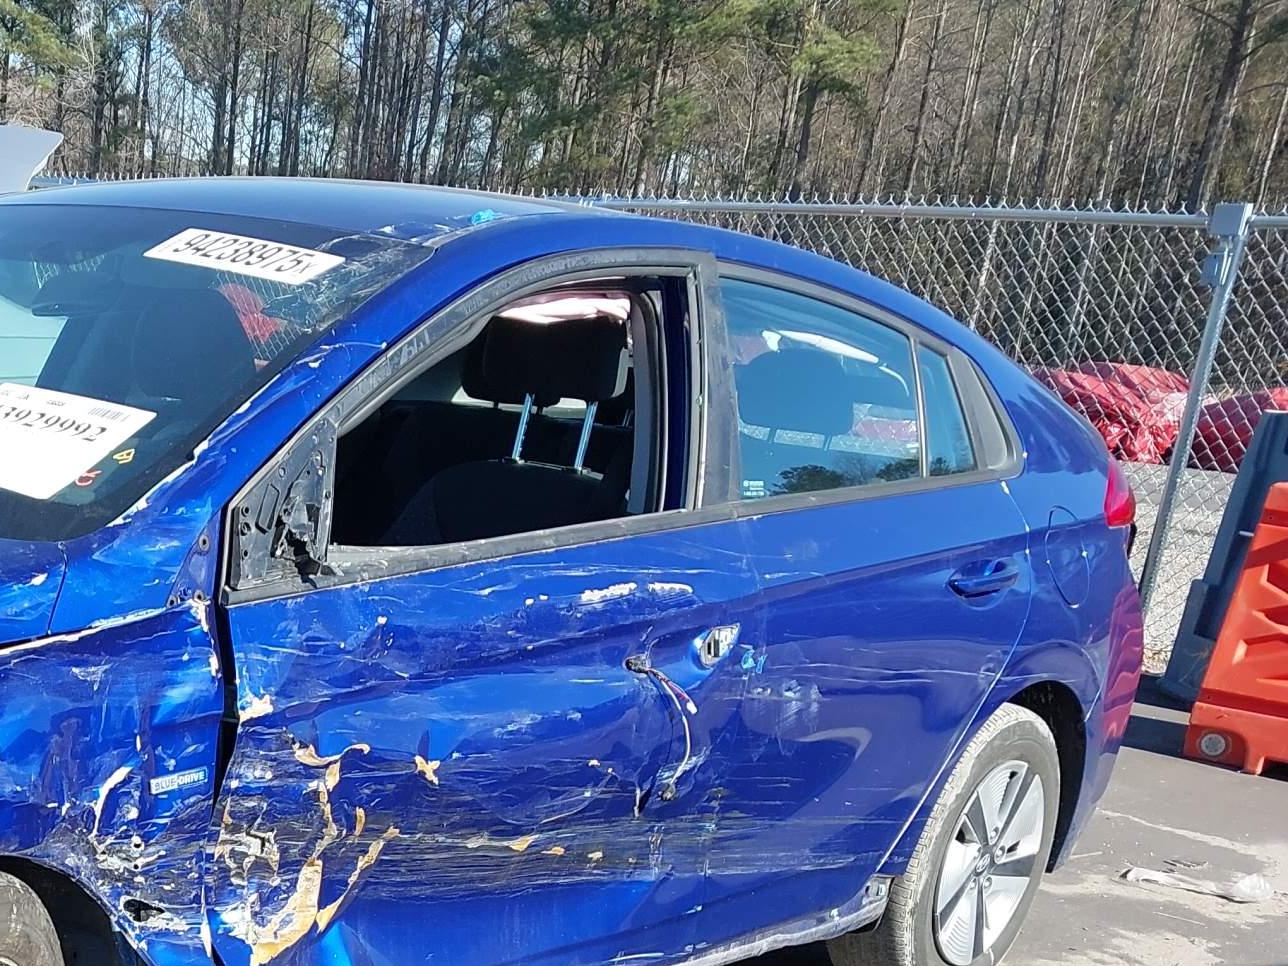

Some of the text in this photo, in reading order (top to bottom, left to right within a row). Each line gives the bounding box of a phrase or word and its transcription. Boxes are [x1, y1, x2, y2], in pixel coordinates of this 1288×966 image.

[173, 233, 314, 273] 94238975
[154, 770, 205, 792] BLUE DRIVE
